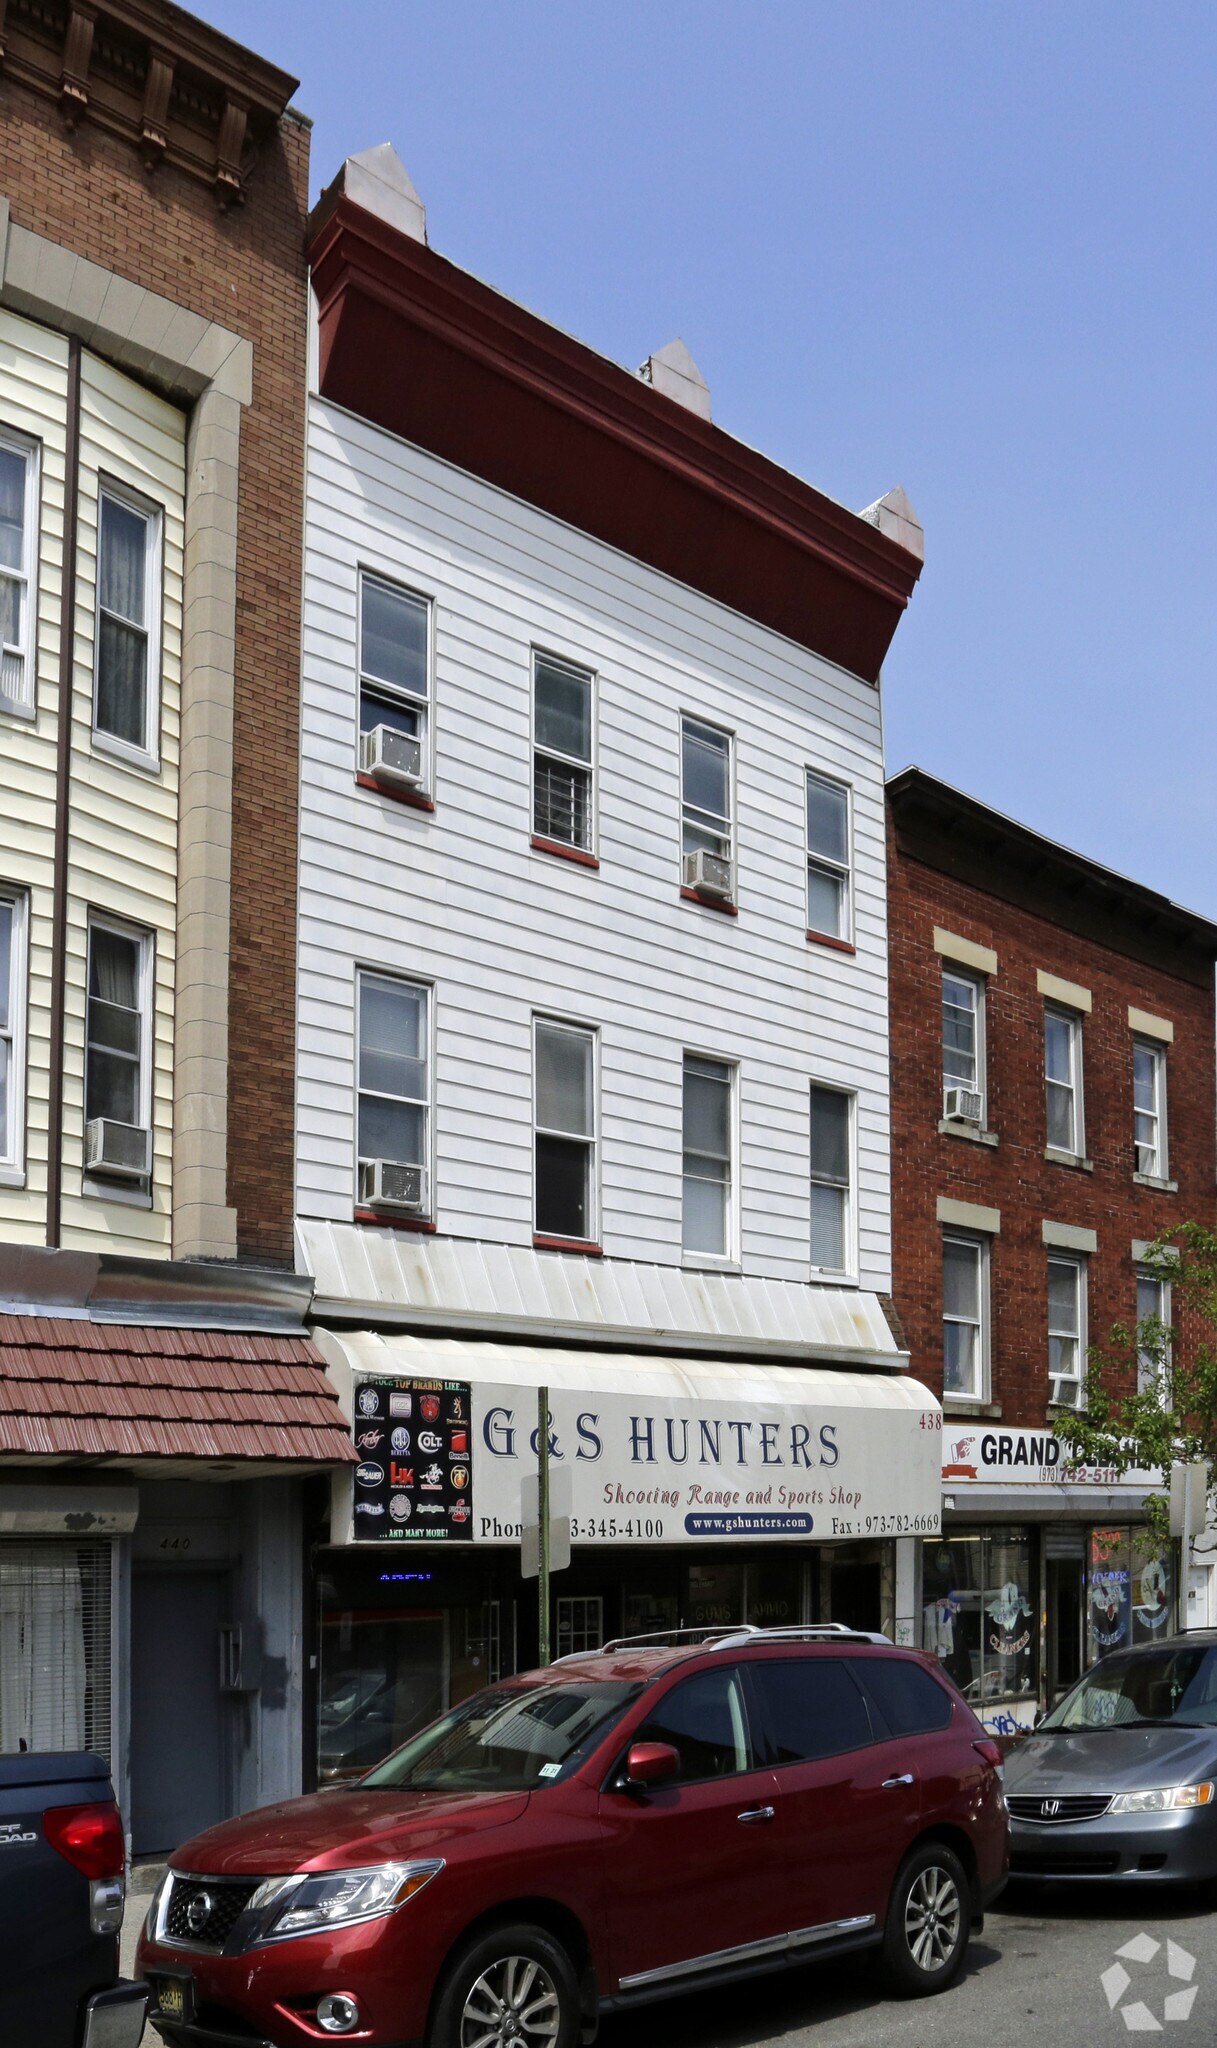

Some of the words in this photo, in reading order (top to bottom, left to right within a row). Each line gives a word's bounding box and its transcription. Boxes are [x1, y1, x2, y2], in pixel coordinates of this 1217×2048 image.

[394, 1379, 412, 1389] TOP
[412, 1380, 443, 1391] BRANDS
[918, 1412, 942, 1430] 438
[482, 1407, 518, 1459] G
[529, 1408, 564, 1460] &
[575, 1412, 604, 1463] S
[628, 1415, 841, 1471] HUNTERS
[981, 1434, 1060, 1467] GRAND
[1039, 1466, 1058, 1483] (973)
[604, 1482, 680, 1508] Shooting
[686, 1483, 740, 1509] Range
[745, 1484, 772, 1505] and
[778, 1484, 823, 1510] Sports
[828, 1485, 862, 1509] Shop
[480, 1517, 524, 1538] Phon
[571, 1518, 663, 1538] 3-345-4100
[692, 1516, 807, 1530] www.gshunters.com
[831, 1516, 852, 1535] Fax
[865, 1513, 939, 1533] 973-782-6669
[405, 1529, 424, 1537] MANY
[426, 1529, 448, 1537] MORE!
[160, 1538, 191, 1550] 440
